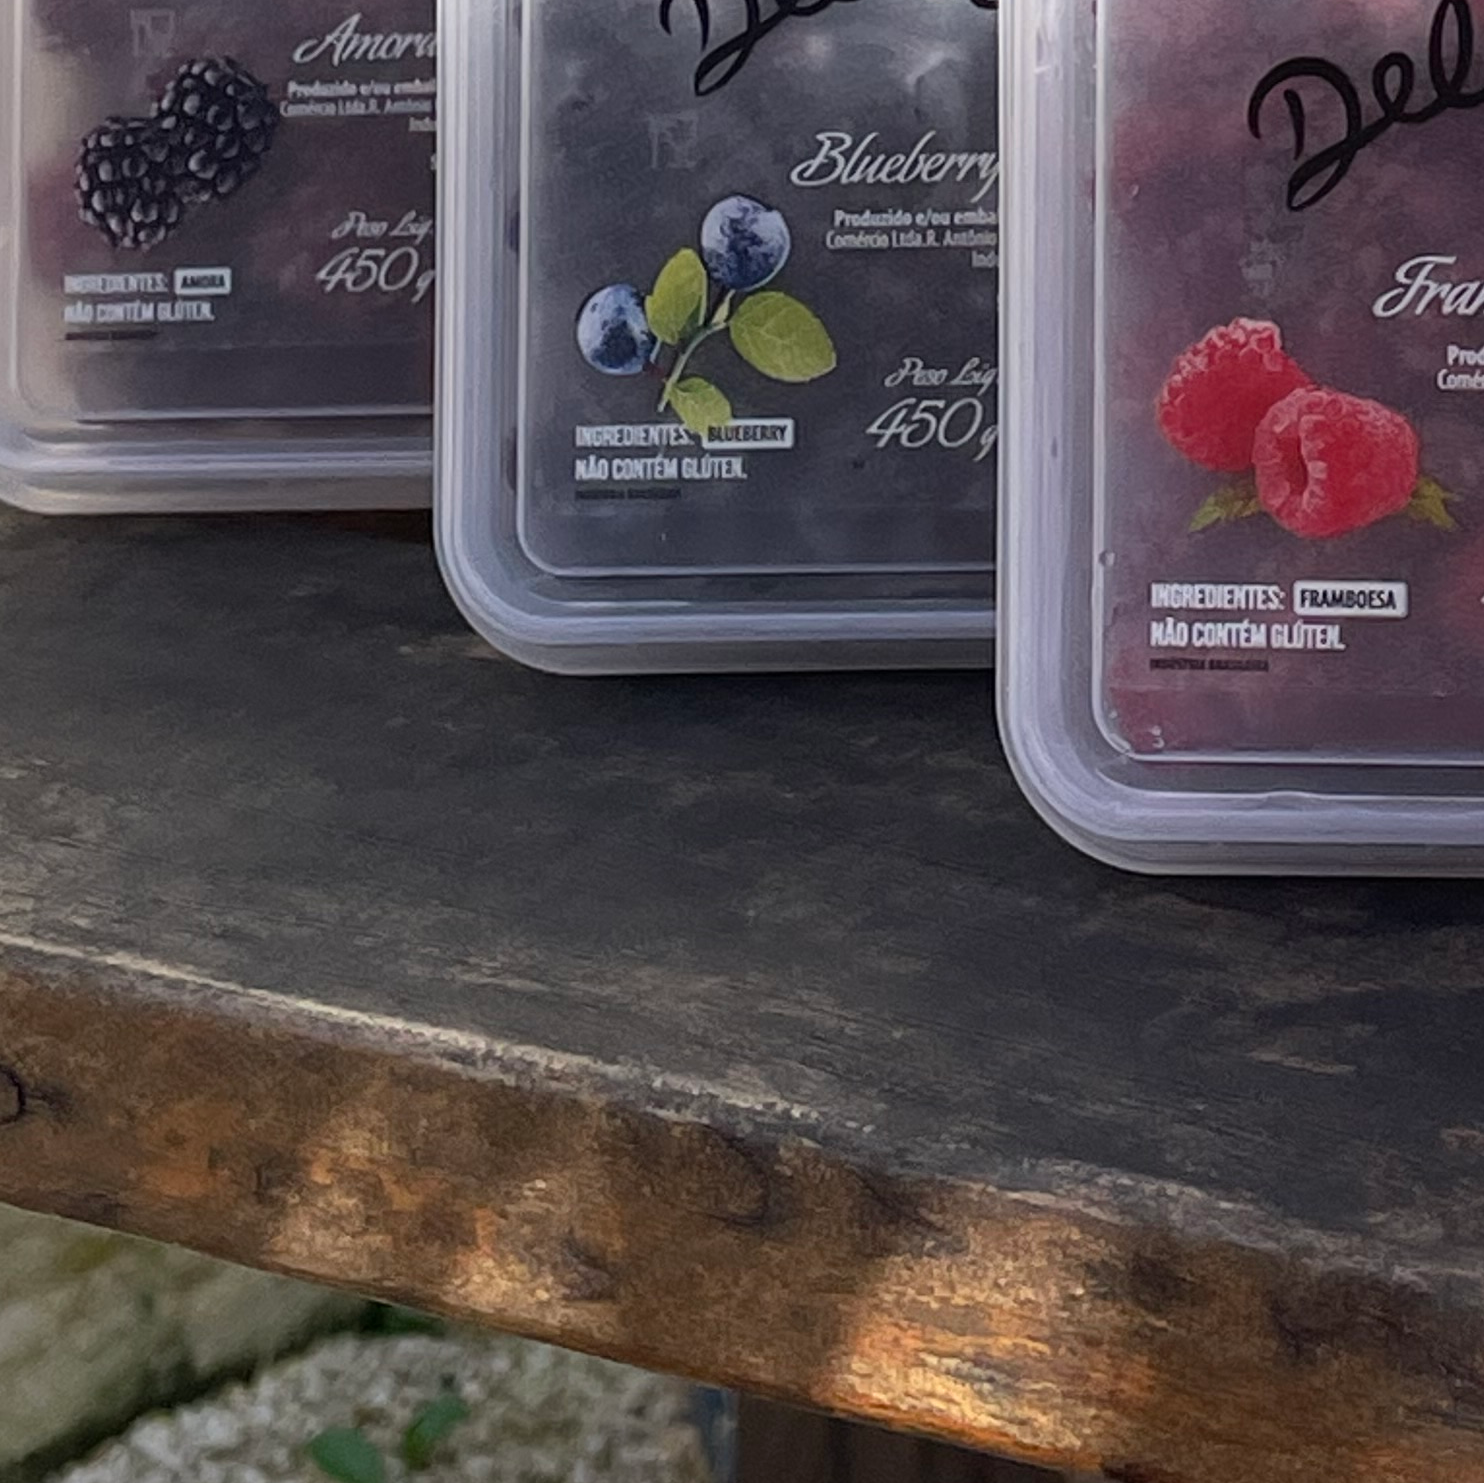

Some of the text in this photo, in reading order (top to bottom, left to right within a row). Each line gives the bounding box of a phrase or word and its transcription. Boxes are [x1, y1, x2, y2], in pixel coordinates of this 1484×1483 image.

[789, 129, 1000, 204] Blueberry
[833, 208, 913, 228] Produzido
[915, 207, 951, 227] e/ou
[825, 229, 889, 250] Comércio
[315, 246, 436, 304] 450g
[884, 356, 949, 388] Peso
[707, 423, 789, 443] BLUEBERRY
[865, 396, 999, 463] 450g
[574, 452, 748, 480] NÃO CONTÉM GLÚTEN.
[1150, 582, 1397, 611] INGREDIENTES: FRAMBOESA
[1150, 616, 1346, 651] NÃO CONTÉM GLÚTEN.
